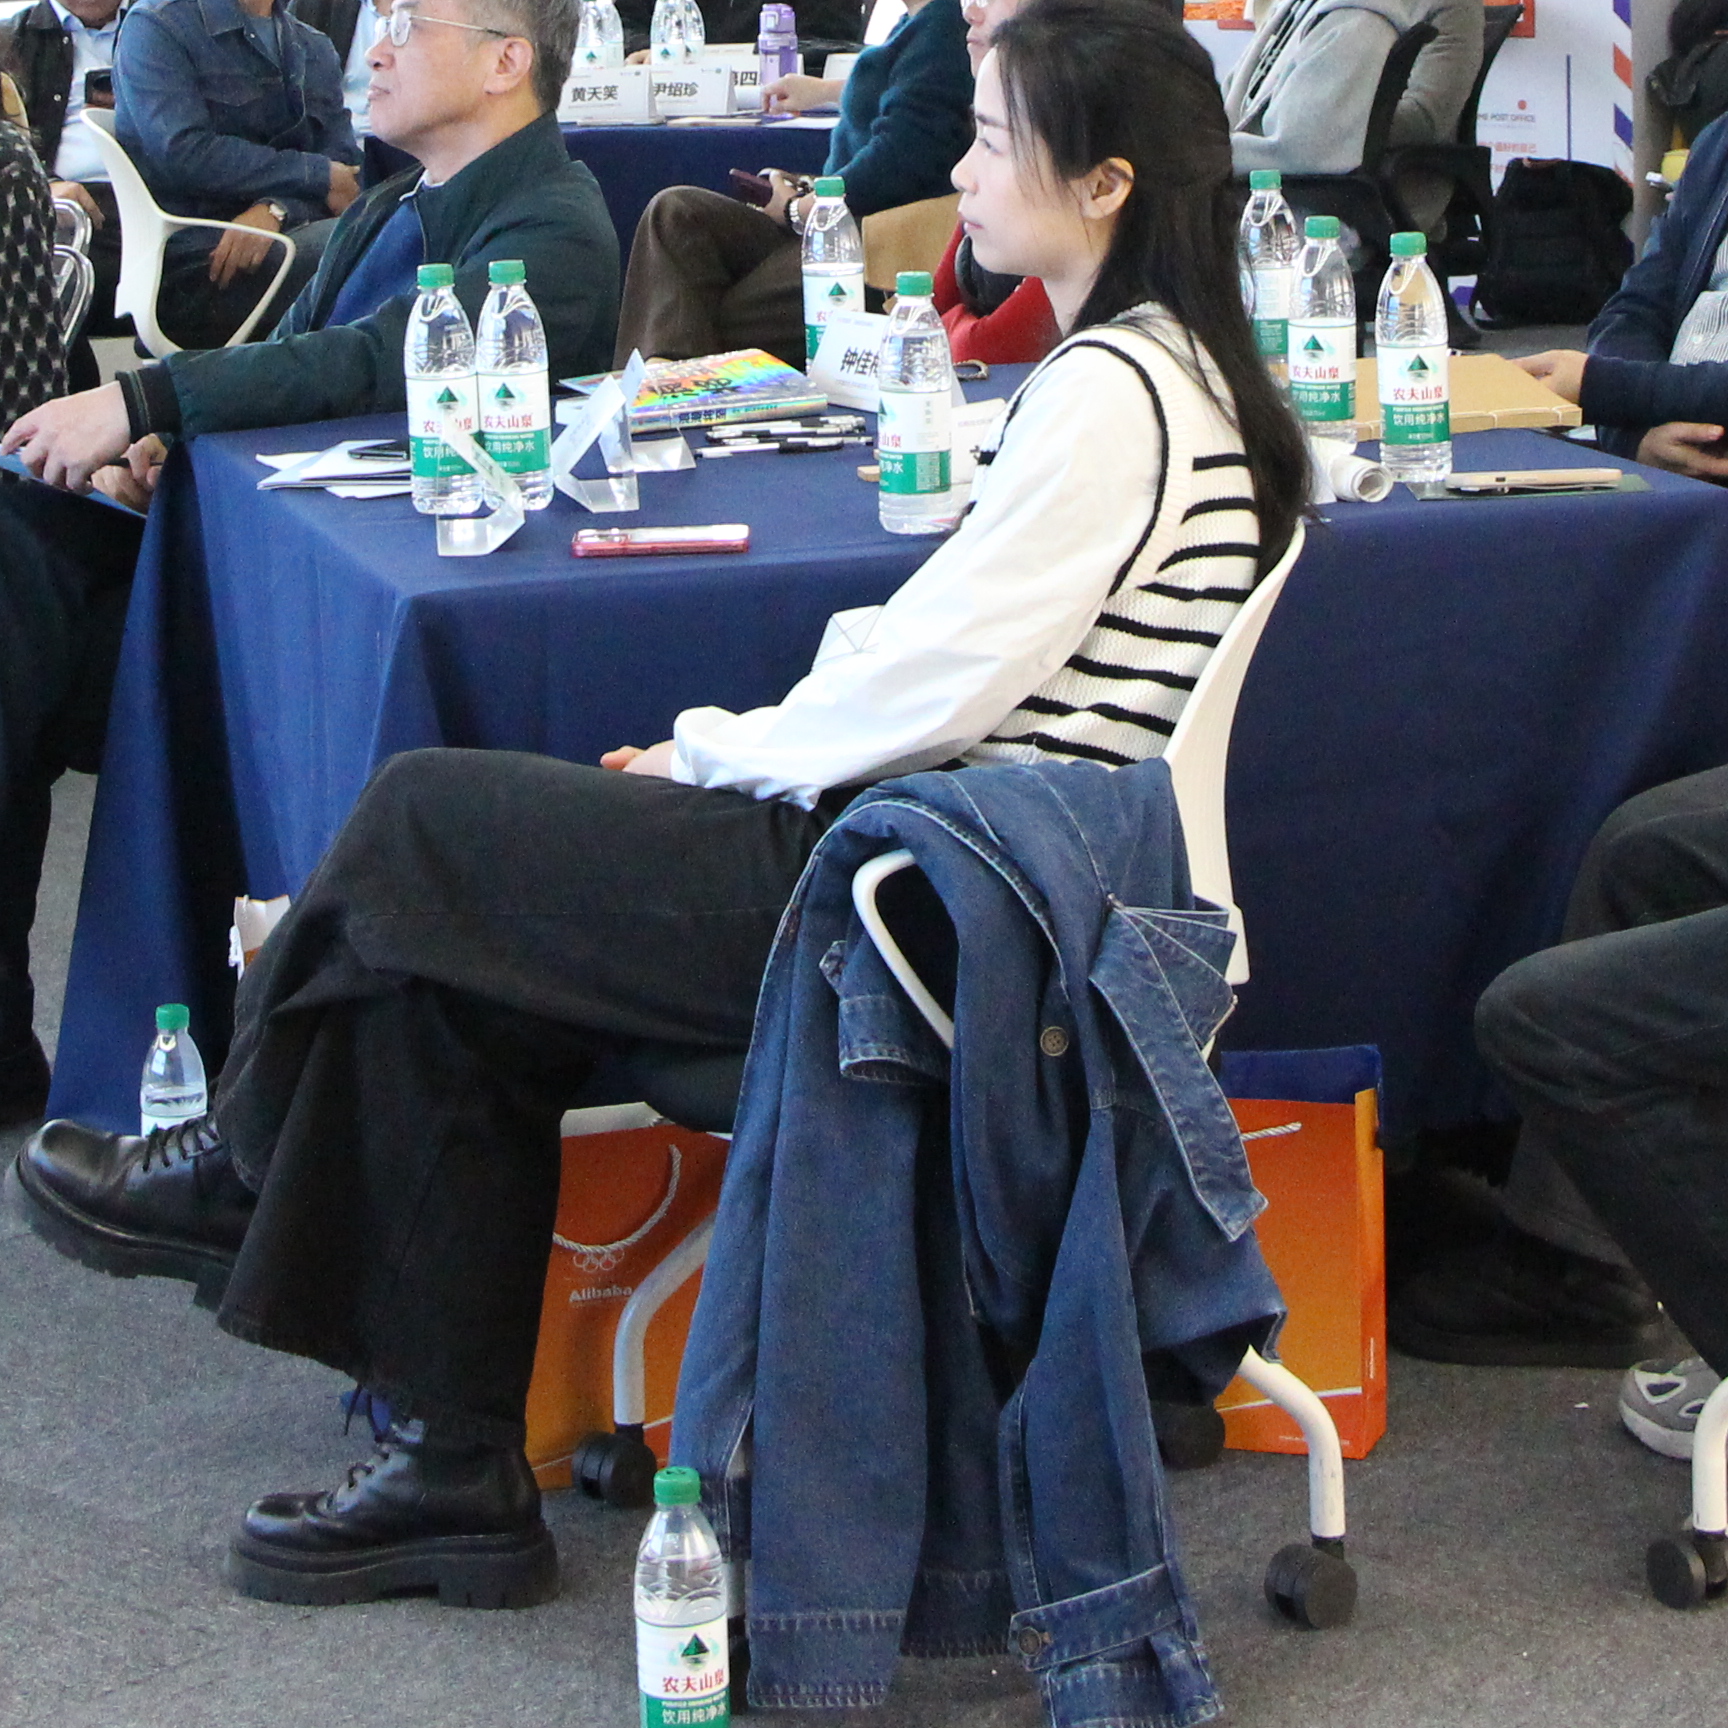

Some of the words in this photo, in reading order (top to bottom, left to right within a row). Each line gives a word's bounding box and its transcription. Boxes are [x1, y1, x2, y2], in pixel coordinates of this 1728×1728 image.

[571, 84, 620, 103] 黄天笑
[1293, 365, 1340, 380] 农夫山泉
[1393, 386, 1443, 401] 农夫山泉
[484, 414, 534, 429] 农夫山泉
[1393, 412, 1445, 426] 饮用纯净水
[879, 434, 902, 448] 山泉
[569, 1285, 633, 1303] Alibaba
[662, 1667, 725, 1694] 农夫山泉
[661, 1701, 727, 1725] 饮用纯净水
